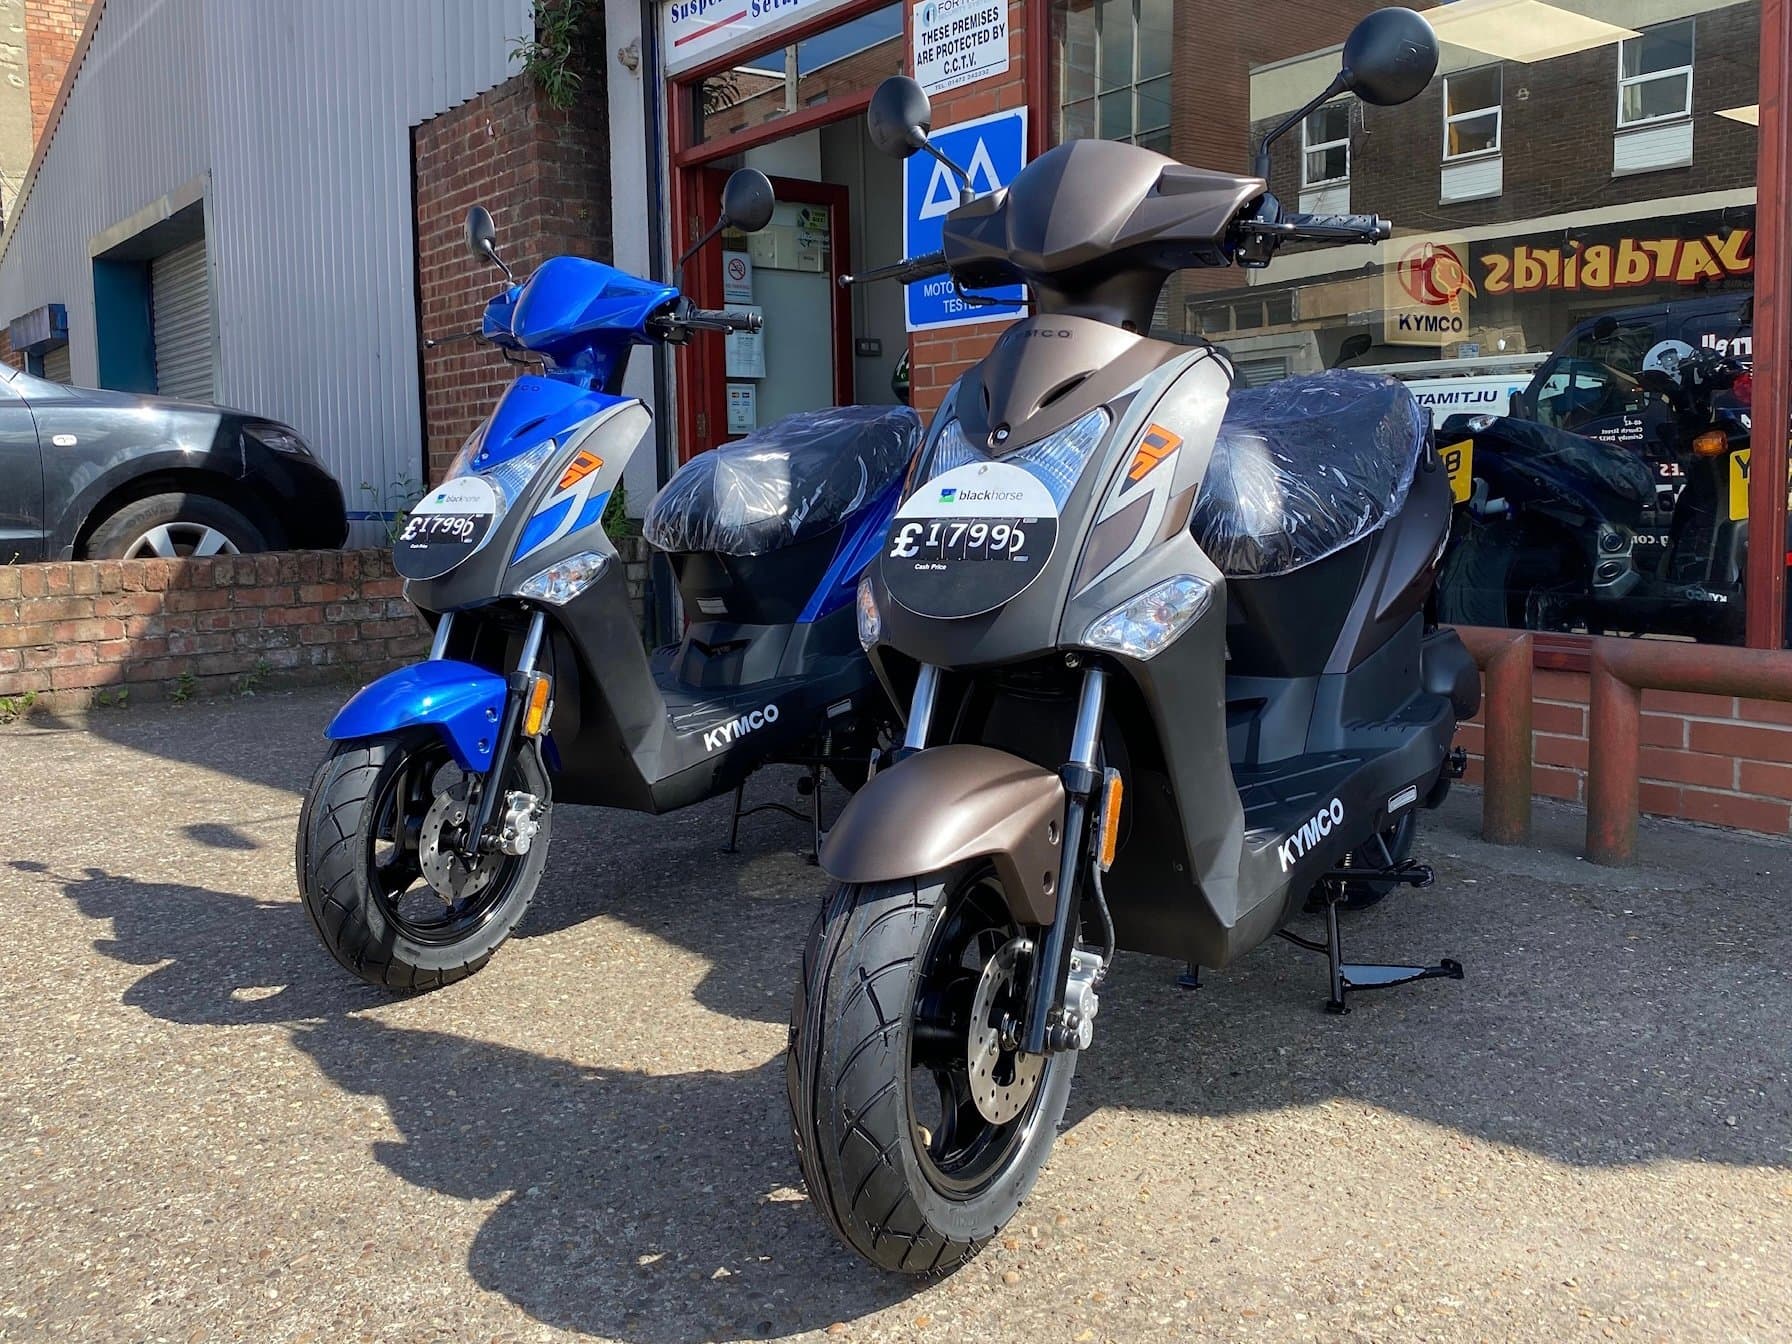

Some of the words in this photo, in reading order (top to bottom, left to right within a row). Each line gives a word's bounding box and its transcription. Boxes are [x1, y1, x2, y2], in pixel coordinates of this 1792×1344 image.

[921, 25, 950, 46] THESE
[952, 6, 999, 36] PREMISES
[917, 48, 934, 66] ARE
[936, 29, 990, 60] PROTECTED
[992, 22, 1006, 40] BY
[943, 52, 977, 74] C.C.T.V.
[1399, 313, 1464, 333] KYMCO
[959, 488, 1024, 501] blackhorse
[930, 563, 947, 571] Price
[703, 703, 779, 752] KYMCO
[1277, 797, 1344, 873] KYMCO
